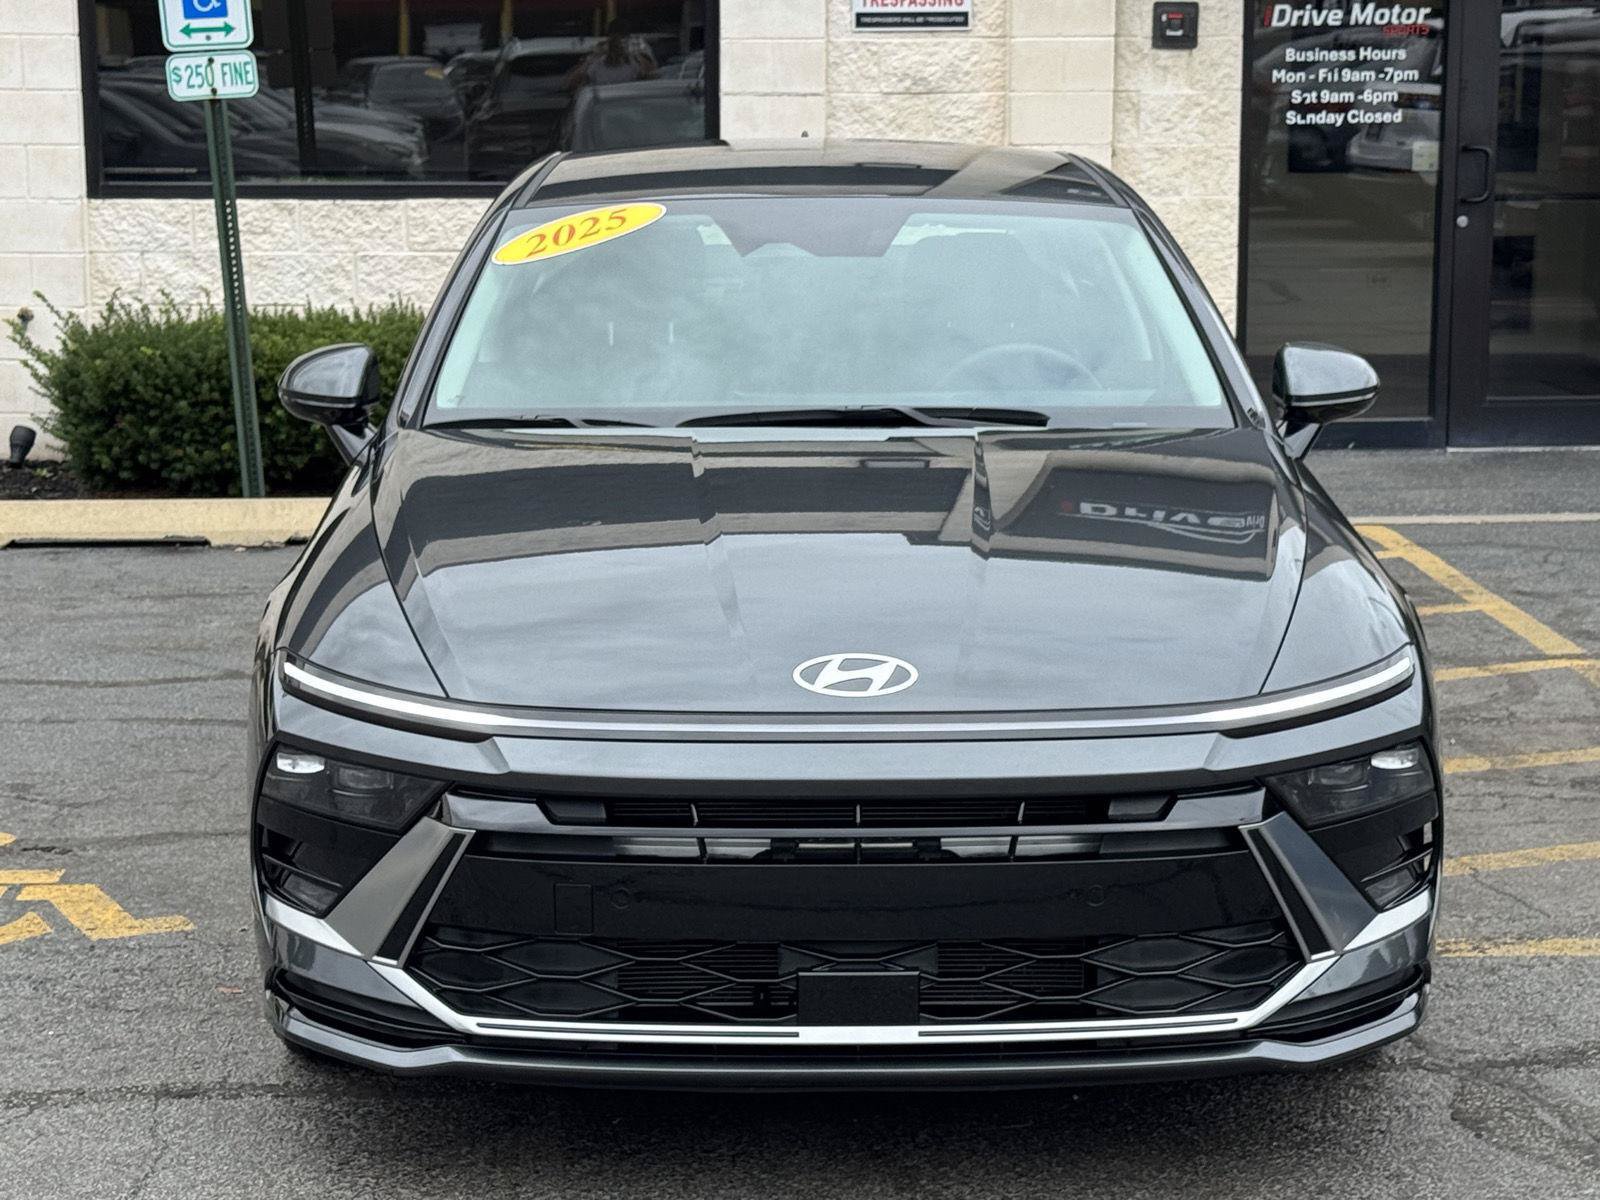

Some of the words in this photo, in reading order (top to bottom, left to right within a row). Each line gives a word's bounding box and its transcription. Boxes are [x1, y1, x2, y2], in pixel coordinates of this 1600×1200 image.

[1349, 2, 1432, 26] Motor
[1285, 48, 1355, 62] Business
[1359, 47, 1407, 61] Hours
[171, 63, 215, 89] $250
[220, 61, 254, 87] FINE
[1272, 69, 1306, 84] Mon
[1341, 68, 1376, 83] 9am
[1378, 67, 1419, 84] -7pm
[1320, 89, 1355, 103] 9am
[1357, 89, 1399, 105] -6pm
[1347, 109, 1403, 124] Closed
[525, 209, 627, 258] 2025
